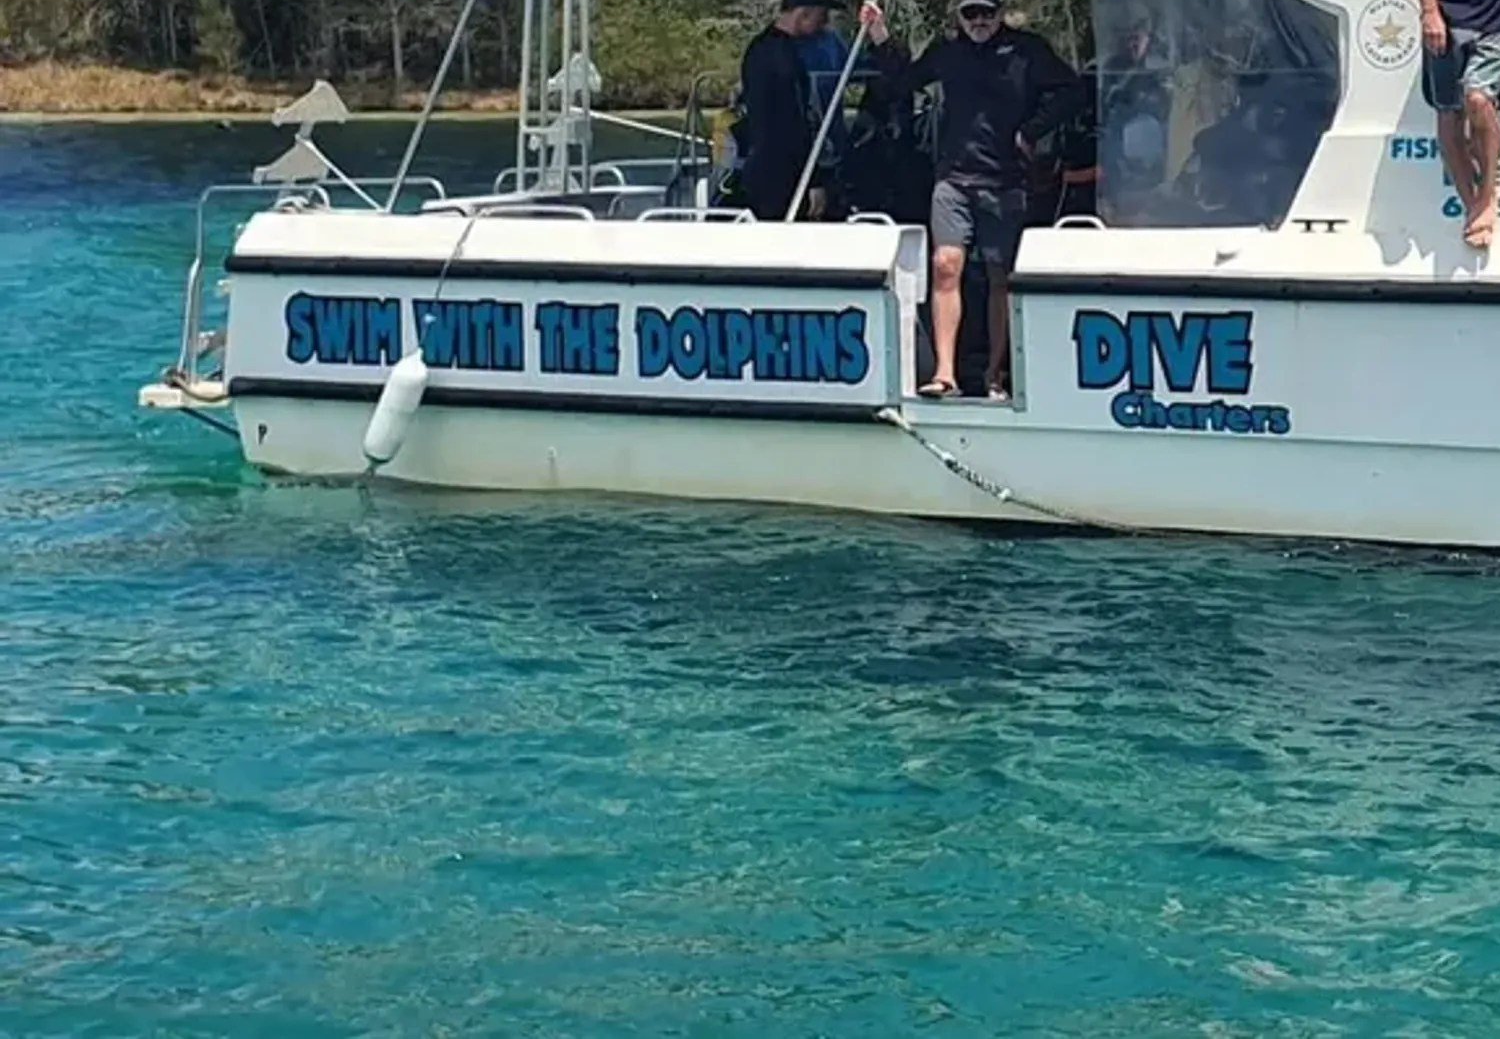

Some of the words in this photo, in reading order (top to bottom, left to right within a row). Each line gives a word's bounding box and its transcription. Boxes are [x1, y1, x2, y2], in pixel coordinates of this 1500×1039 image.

[285, 291, 404, 367] SWIM
[411, 298, 526, 372] WITH
[534, 300, 621, 376] THE
[634, 305, 870, 386] DOLPHINS
[1072, 309, 1253, 395] DIVE
[1111, 391, 1291, 435] Charters
